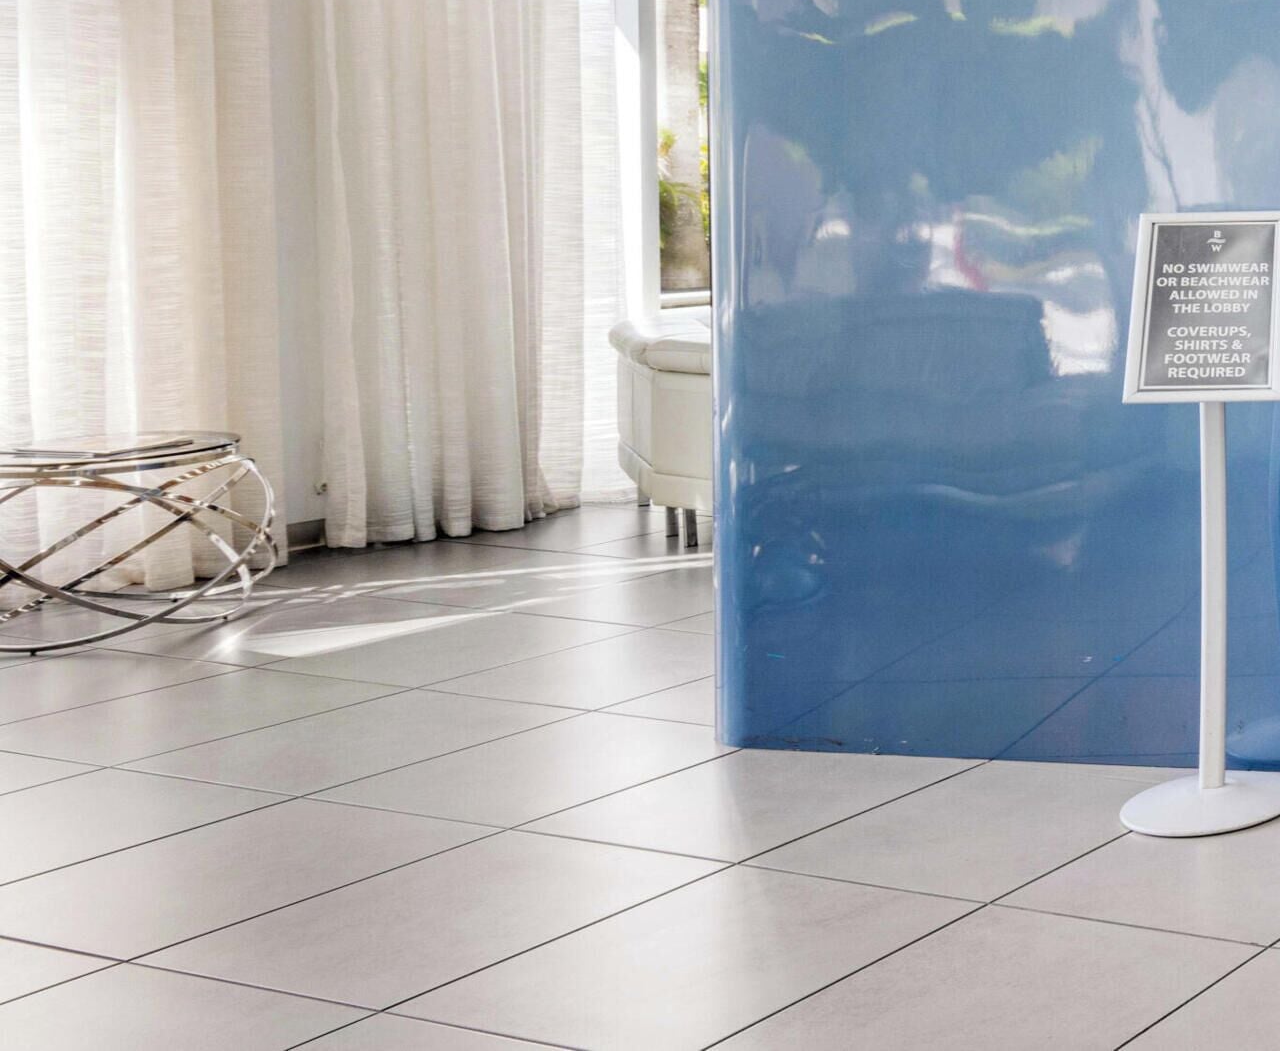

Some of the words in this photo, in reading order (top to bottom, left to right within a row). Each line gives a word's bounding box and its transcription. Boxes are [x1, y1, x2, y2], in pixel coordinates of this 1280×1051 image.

[1211, 244, 1223, 252] W
[1162, 263, 1185, 273] NO
[1187, 263, 1269, 273] SWIMWEAR
[1156, 277, 1177, 287] OR
[1180, 276, 1270, 287] BEACHWEAR
[1169, 289, 1240, 300] ALLOWED
[1243, 289, 1258, 300] IN
[1172, 304, 1200, 313] THE
[1204, 304, 1250, 313] LOBBY
[1167, 326, 1252, 338] COVERUPS,
[1174, 340, 1228, 350] SHIRTS
[1231, 340, 1243, 350] &
[1164, 354, 1251, 364] FOOTWEAR
[1167, 367, 1246, 379] REQUIRED
